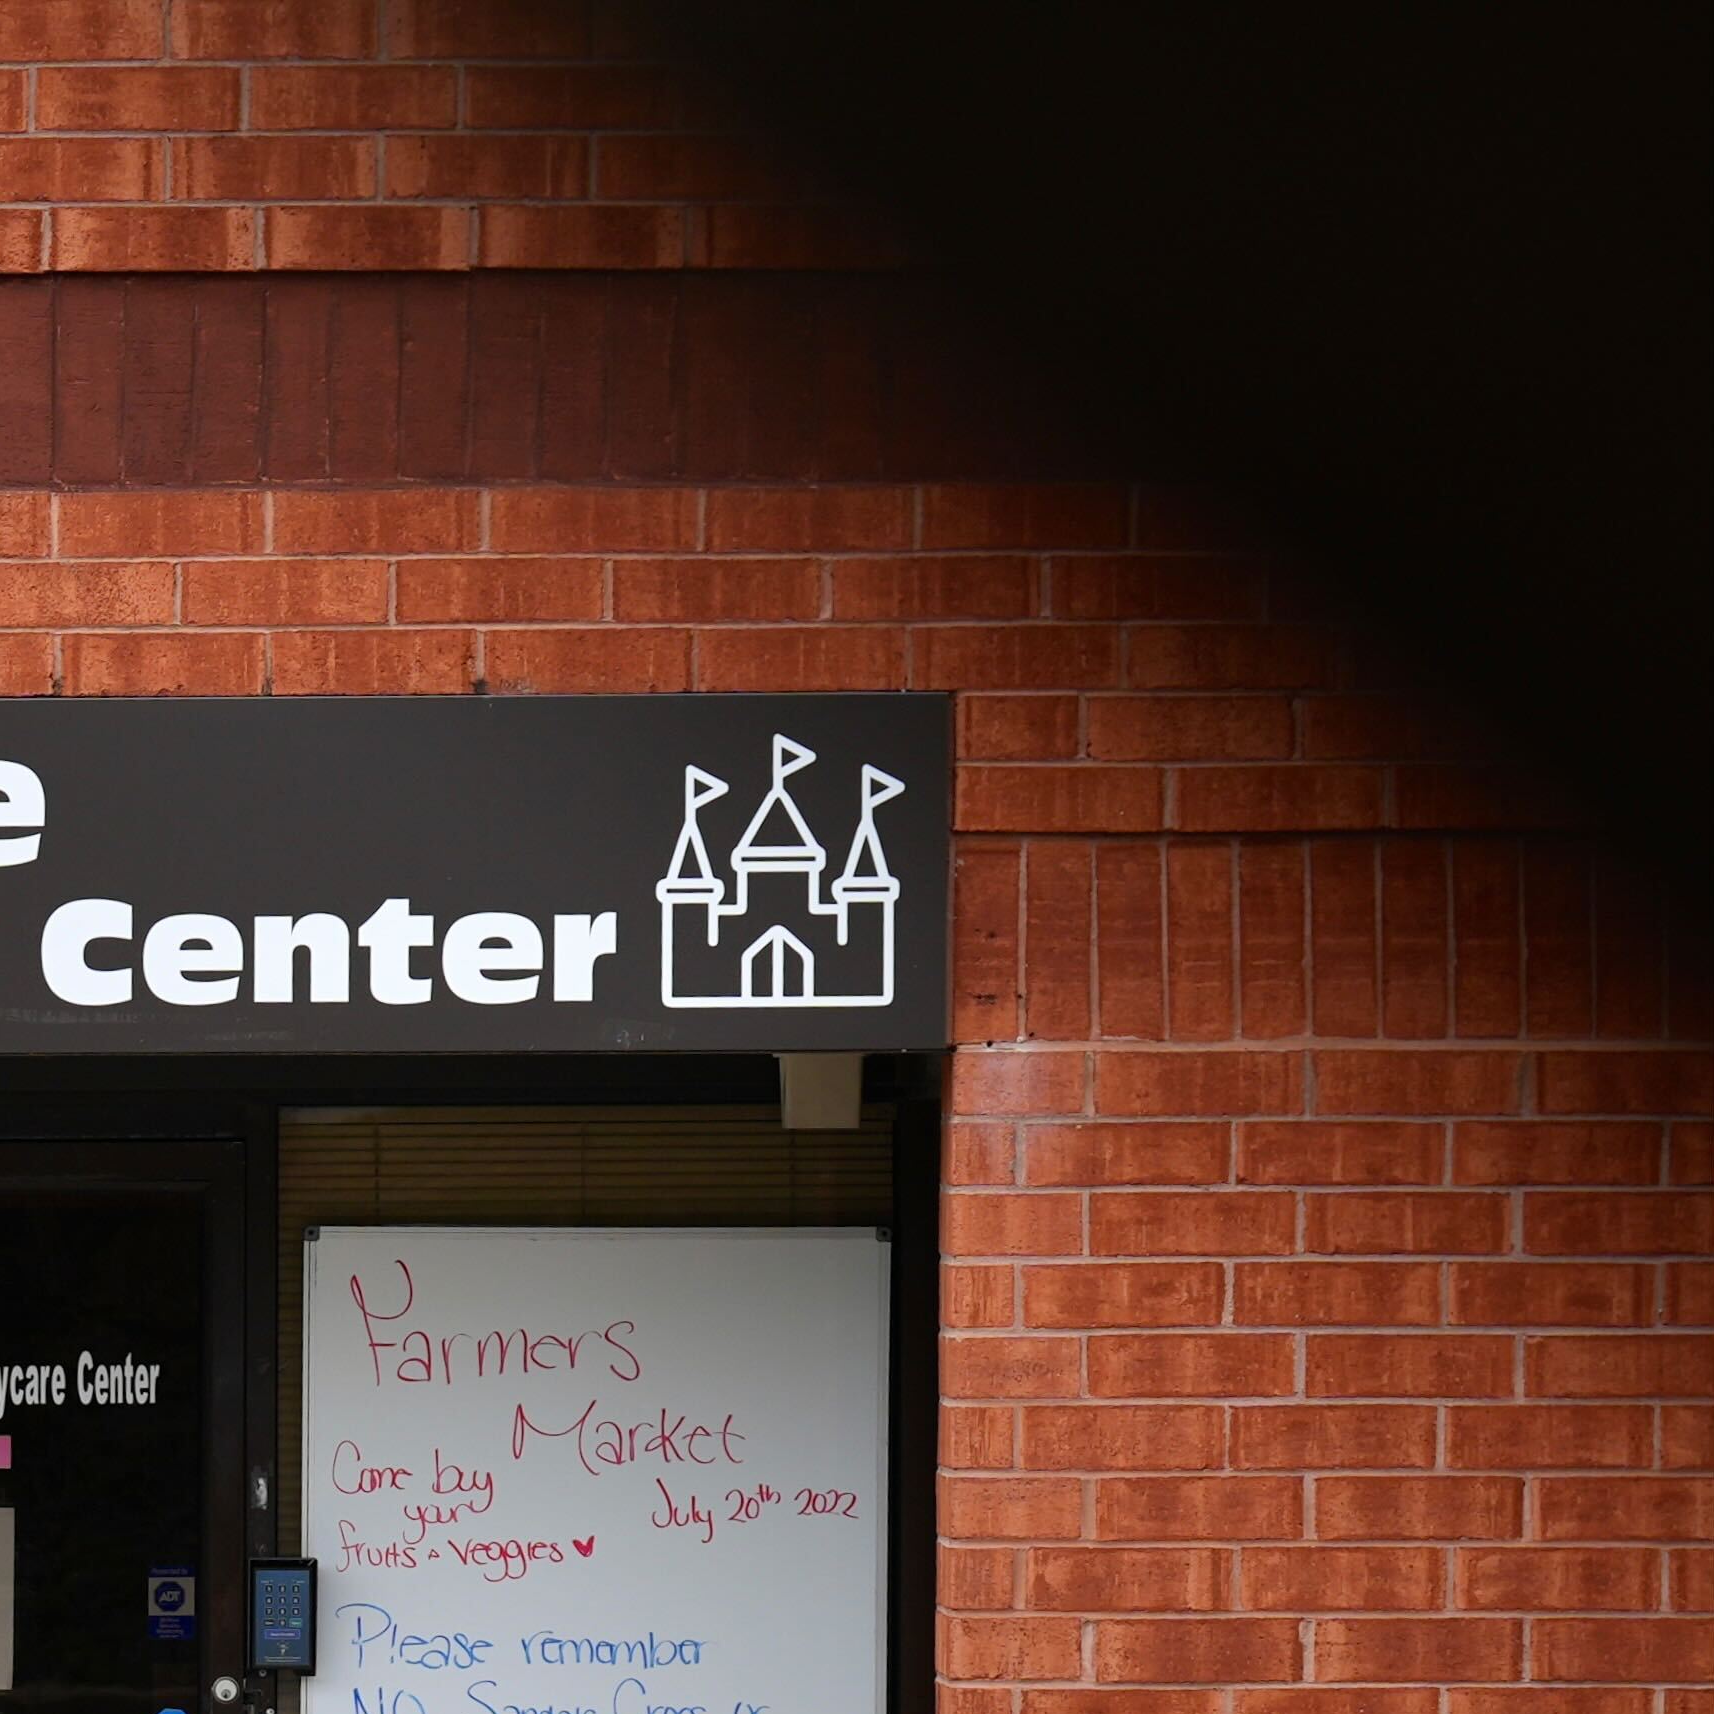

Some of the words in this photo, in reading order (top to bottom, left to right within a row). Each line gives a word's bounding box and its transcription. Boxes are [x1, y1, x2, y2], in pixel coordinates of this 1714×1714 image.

[41, 899, 616, 1006] Center
[350, 1260, 640, 1386] Farmers
[78, 1351, 159, 1404] Center
[512, 1400, 746, 1475] Market
[332, 1440, 413, 1494] Come
[432, 1448, 494, 1513] buy
[652, 1478, 713, 1543] July
[725, 1484, 781, 1523] 20th
[794, 1488, 859, 1519] 2022
[336, 1519, 417, 1572] fruits
[159, 1590, 181, 1602] ADT
[335, 1603, 494, 1669] Please
[520, 1630, 705, 1669] remember
